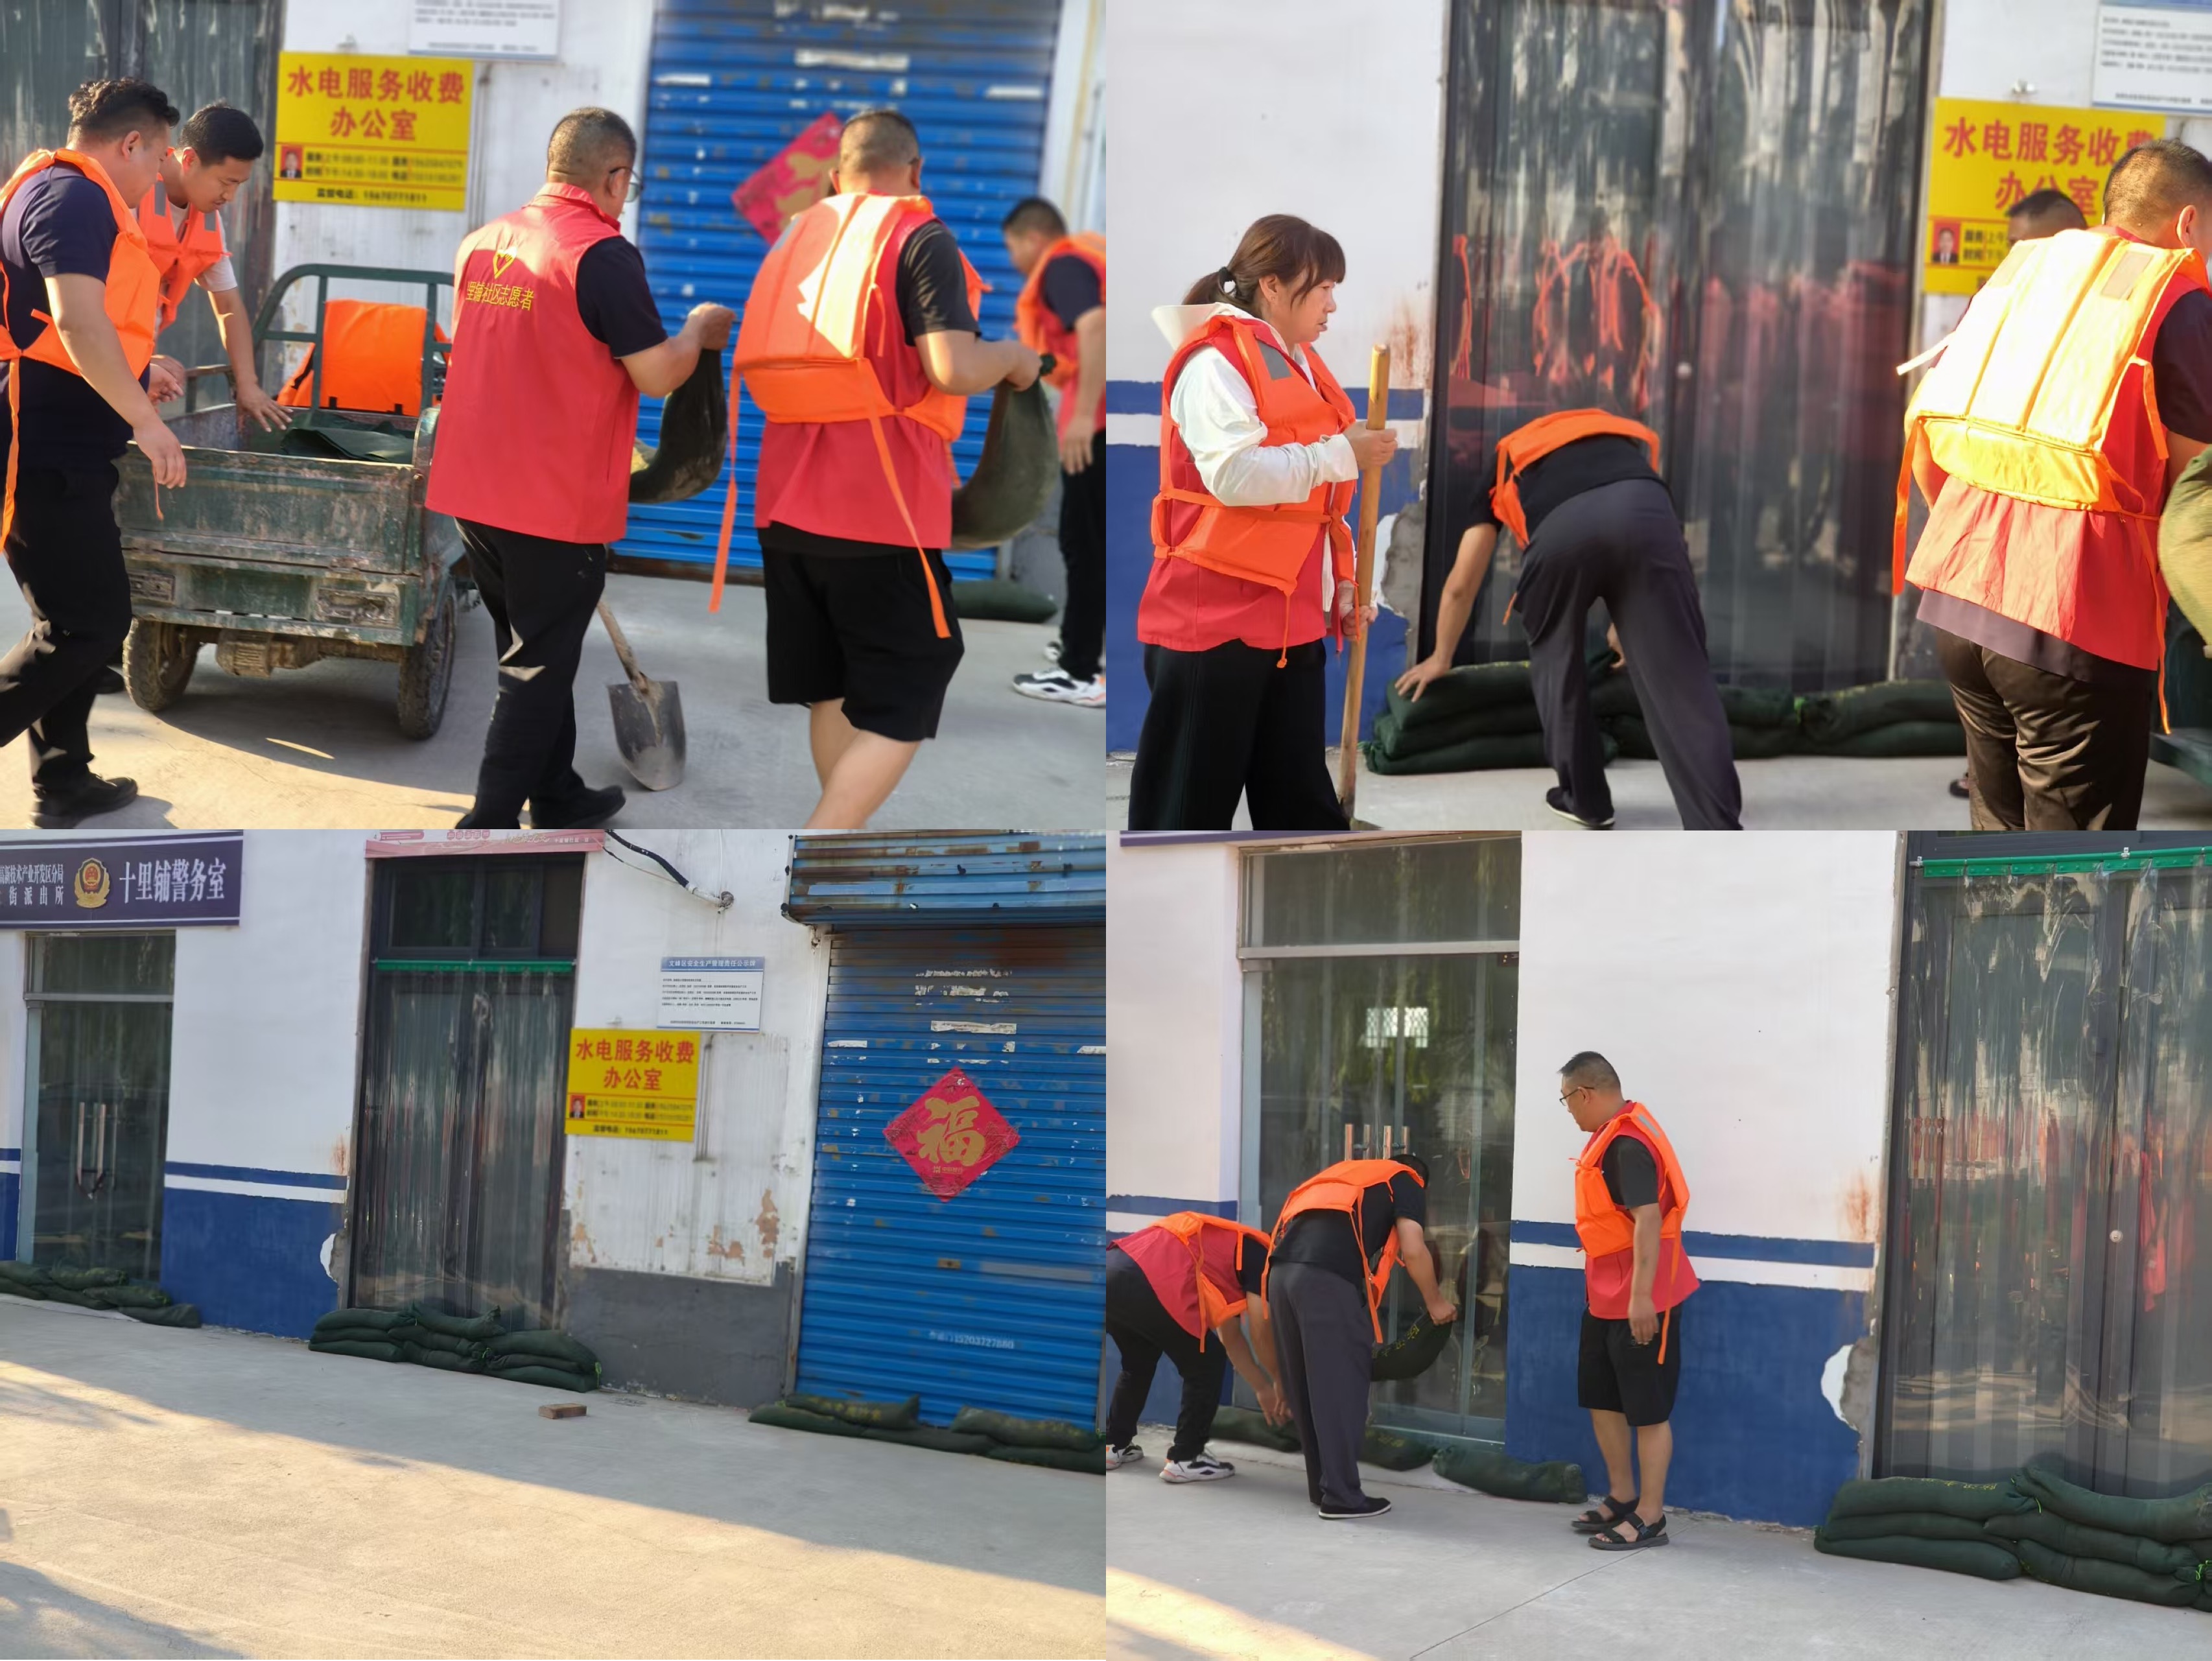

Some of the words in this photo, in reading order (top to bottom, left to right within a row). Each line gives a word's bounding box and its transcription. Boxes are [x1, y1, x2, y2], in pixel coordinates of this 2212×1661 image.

[287, 65, 465, 104] 水电服务收费
[330, 106, 418, 141] 办公室
[119, 856, 226, 904] 十里铺警务室
[576, 1038, 694, 1063] 水电服务收费
[604, 1066, 663, 1090] 办公室
[916, 1095, 986, 1166] 福
